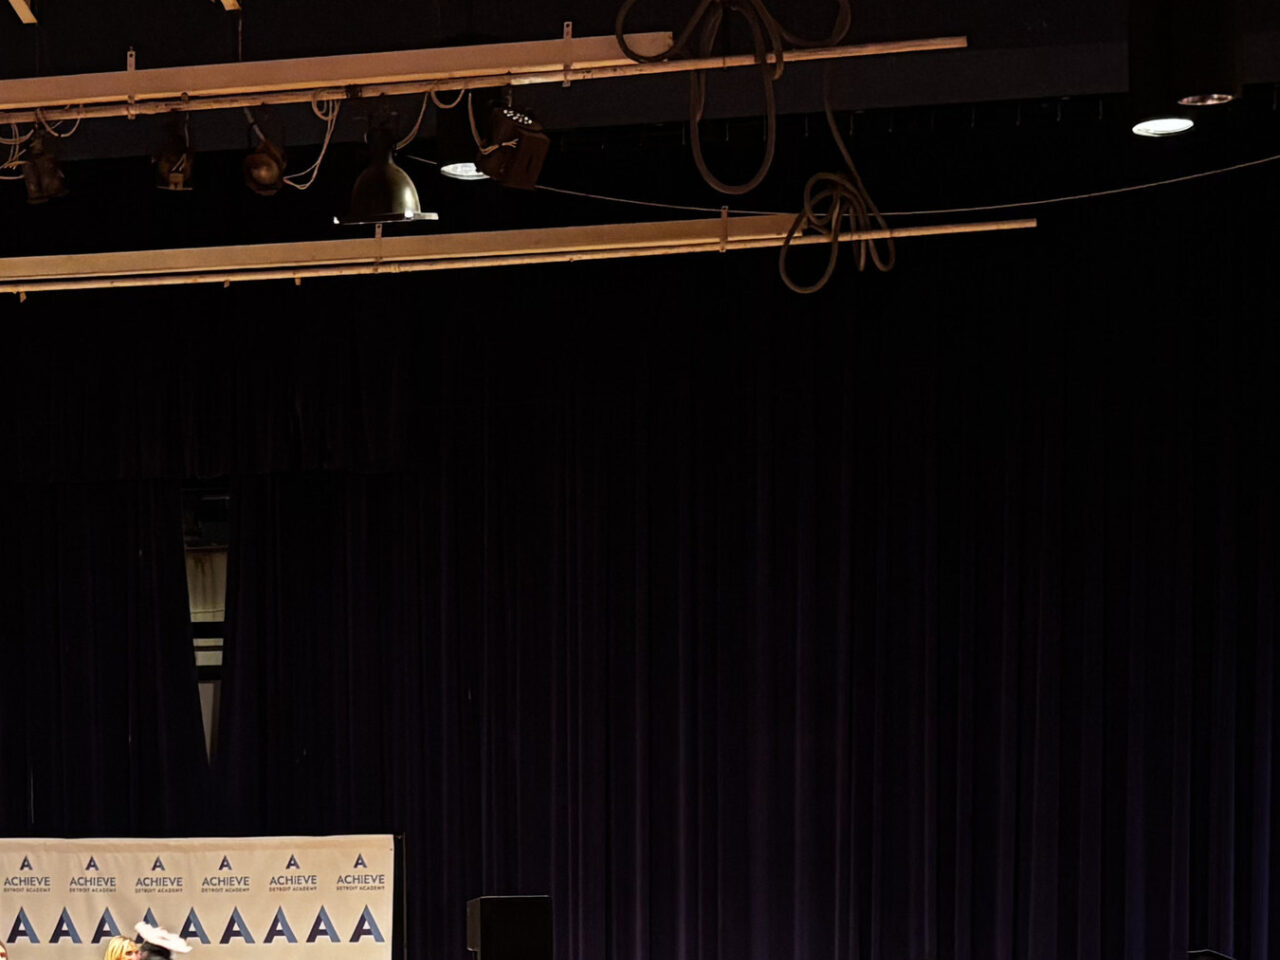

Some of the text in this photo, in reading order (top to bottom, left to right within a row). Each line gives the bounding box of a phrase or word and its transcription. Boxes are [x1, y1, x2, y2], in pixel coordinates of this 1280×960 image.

[20, 855, 33, 871] A
[85, 855, 99, 871] A
[152, 856, 165, 871] A
[218, 855, 232, 870] A
[286, 853, 300, 869] A
[353, 853, 367, 868] A
[4, 876, 50, 887] ACHIEVE
[70, 876, 116, 887] ACHIEVE
[136, 877, 183, 887] ACHIEVE
[202, 876, 250, 887] ACHIEVE
[270, 875, 317, 885] ACHIEVE
[337, 874, 385, 885] ACHIEVE
[6, 907, 40, 944] A
[49, 907, 83, 944] A
[178, 907, 211, 944] A
[219, 907, 255, 944] A
[263, 906, 298, 944] A
[306, 905, 341, 943] A
[349, 904, 386, 943] A
